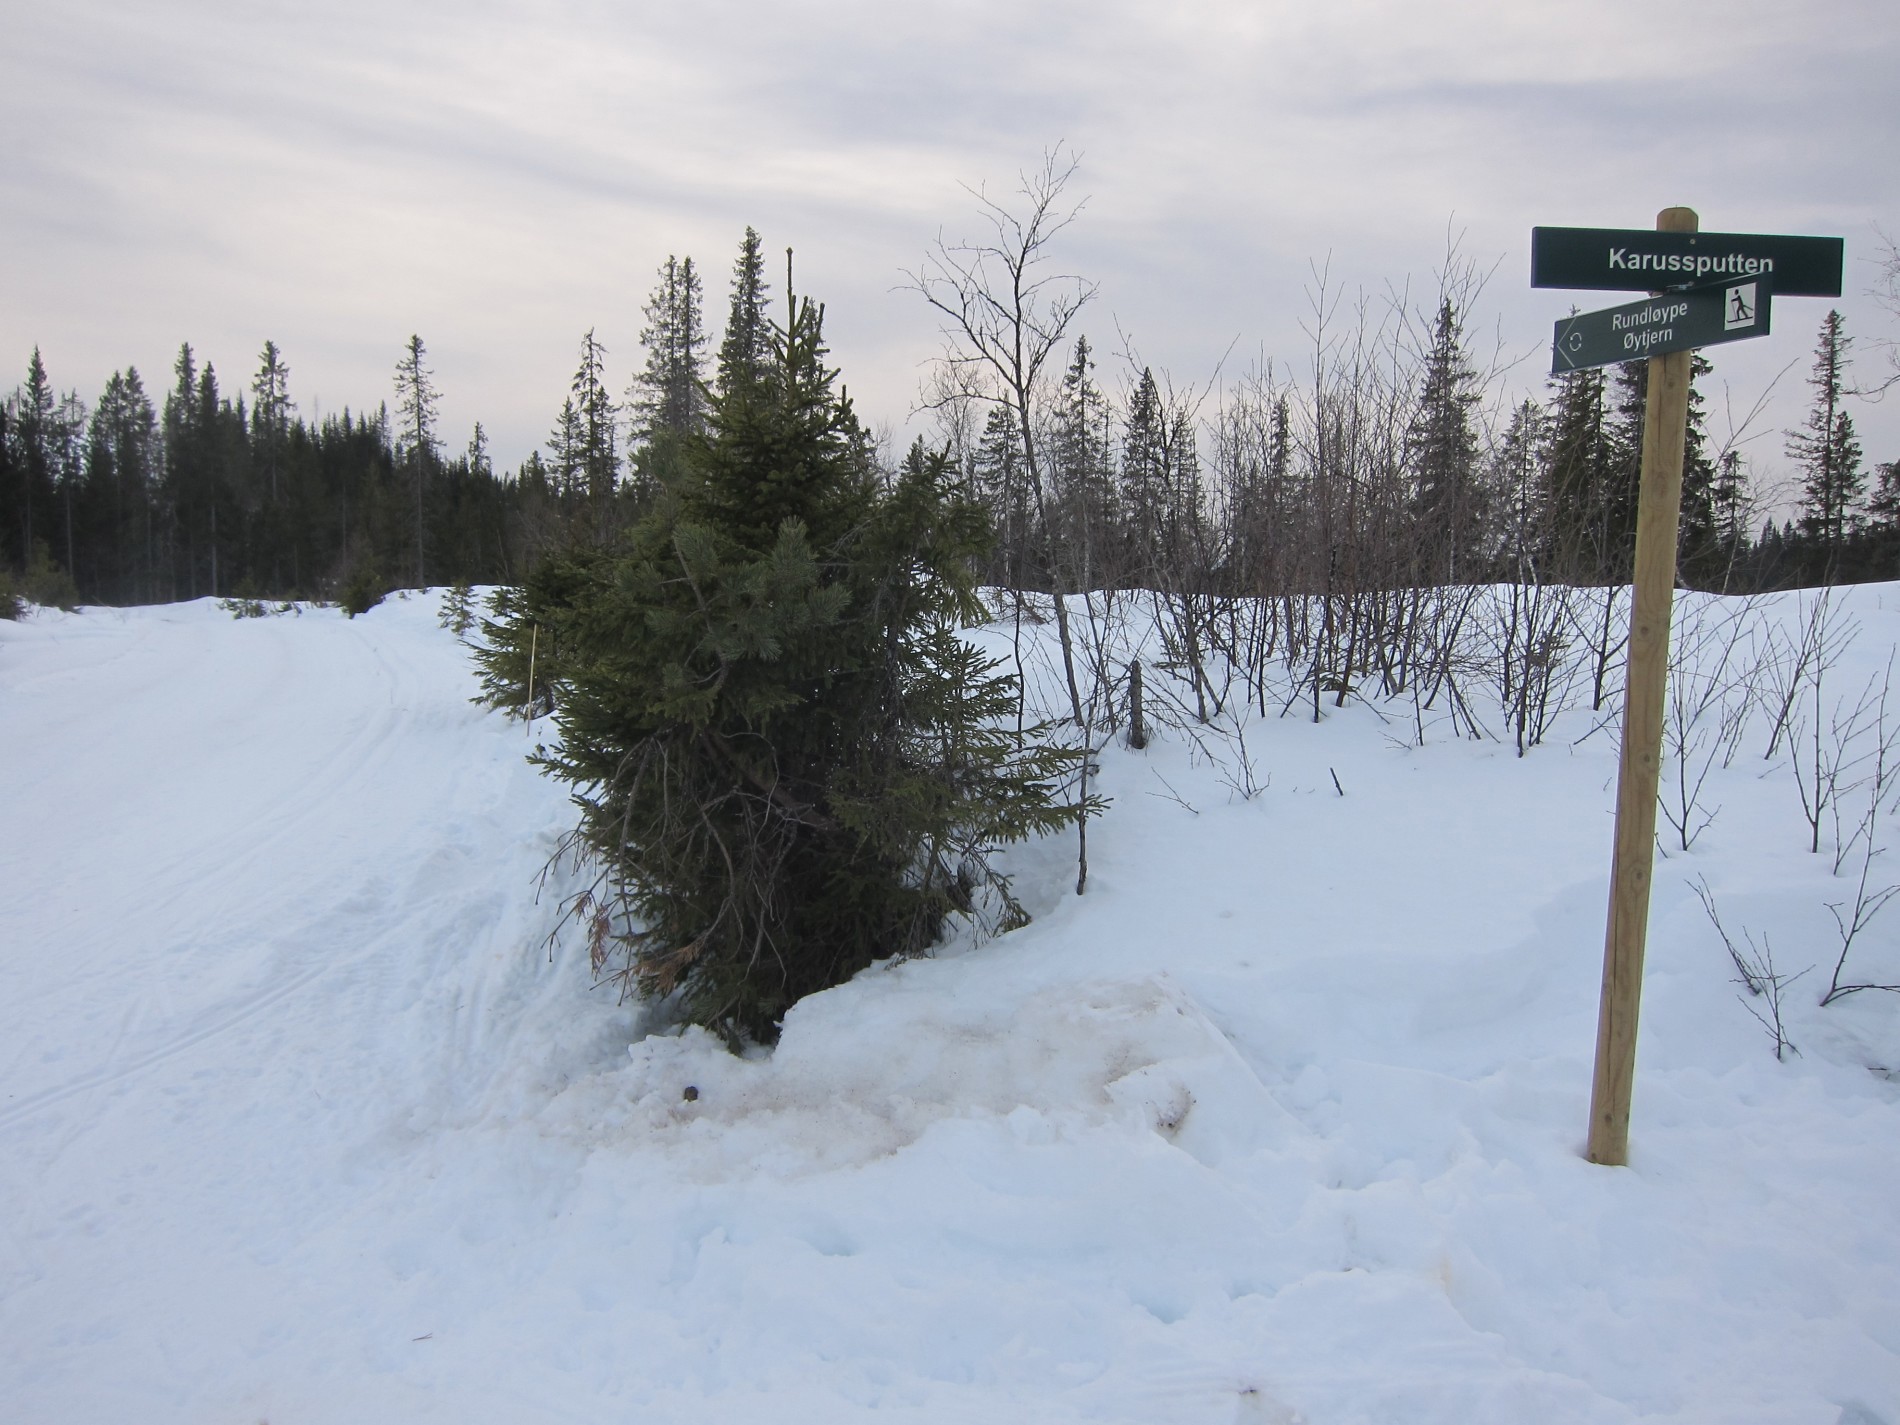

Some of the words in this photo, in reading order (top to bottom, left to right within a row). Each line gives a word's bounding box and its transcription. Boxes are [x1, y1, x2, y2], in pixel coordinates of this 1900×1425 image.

[1609, 248, 1773, 276] Karussputten
[1612, 302, 1688, 330] Rundløype
[1623, 328, 1673, 351] Øytjern
